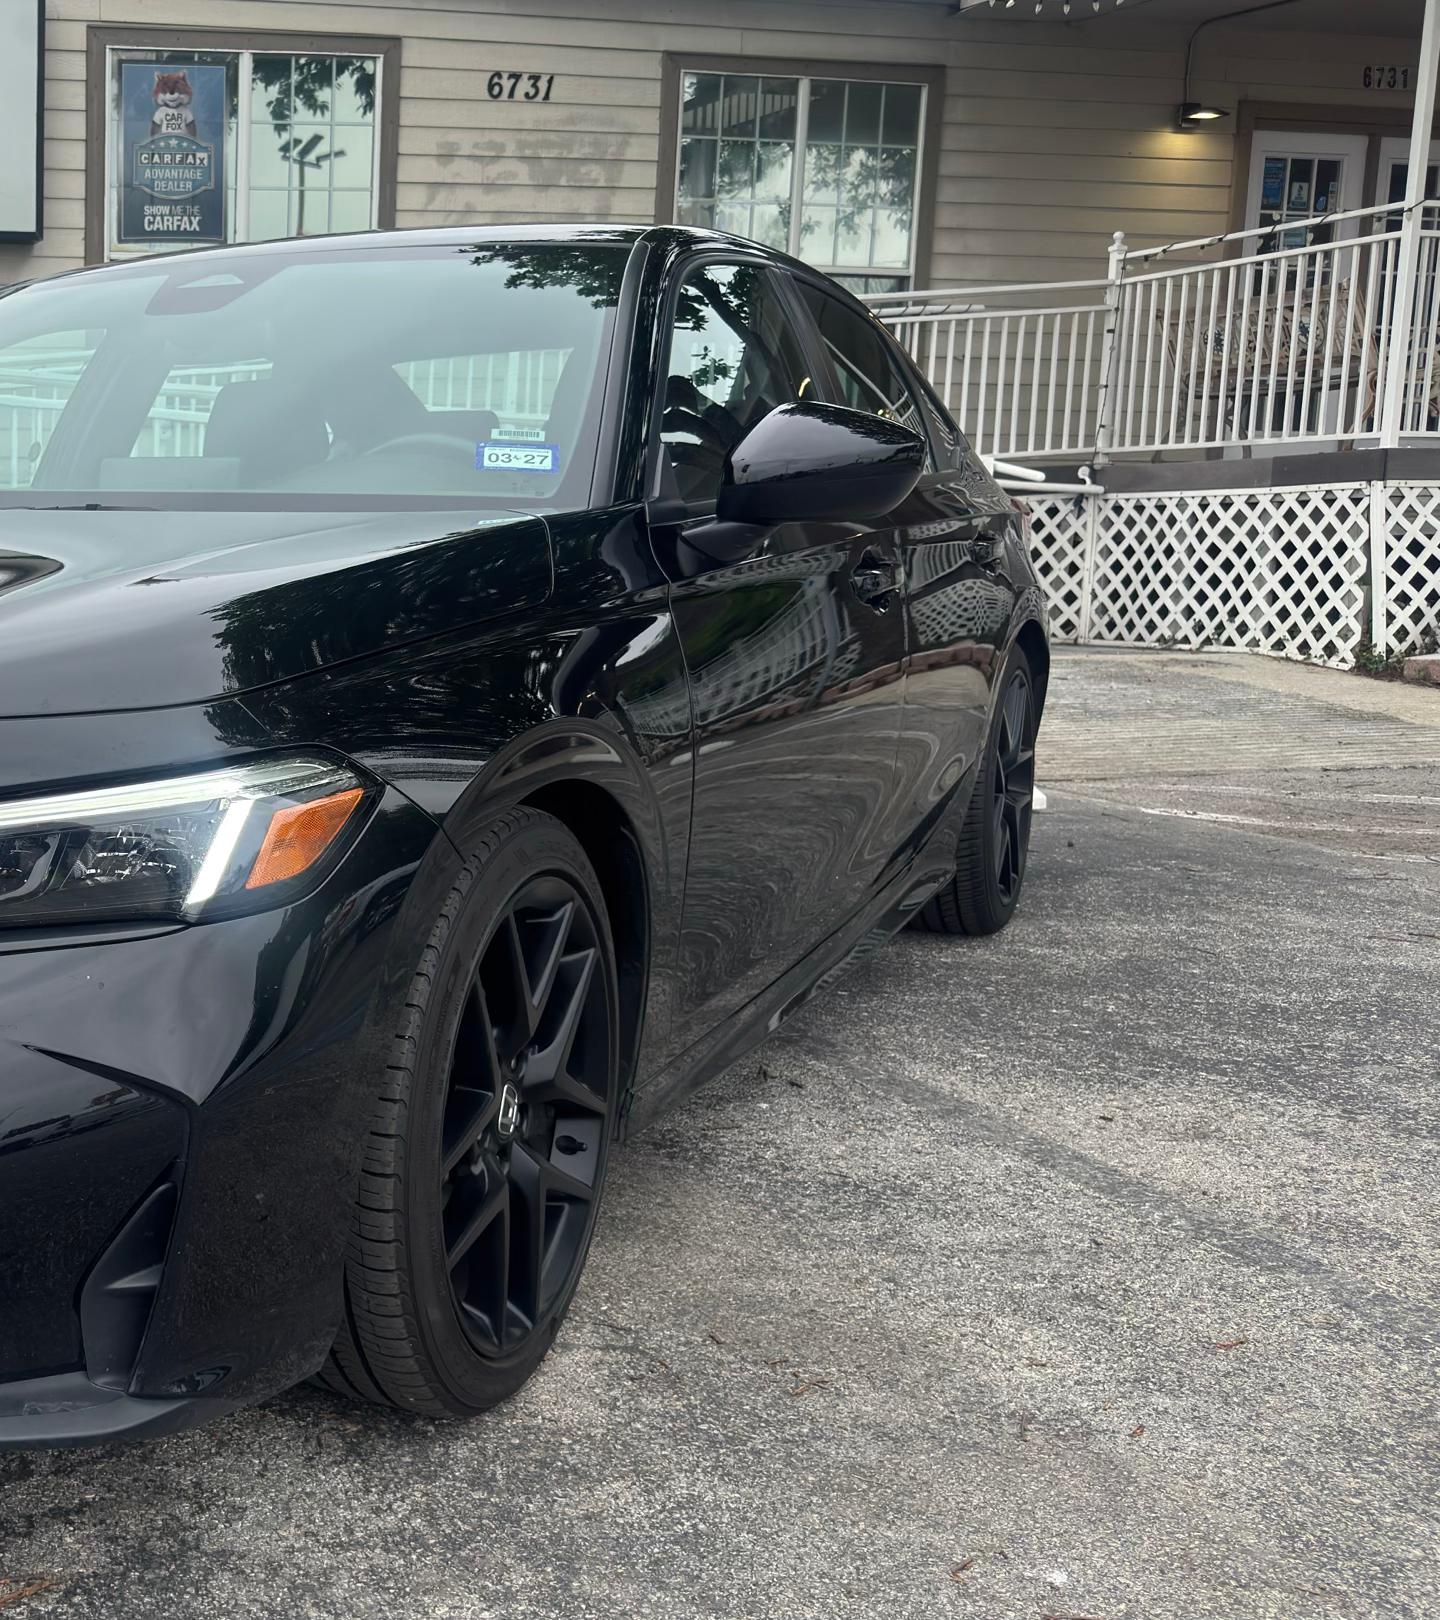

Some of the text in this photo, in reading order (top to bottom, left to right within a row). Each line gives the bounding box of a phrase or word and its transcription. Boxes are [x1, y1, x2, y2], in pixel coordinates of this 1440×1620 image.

[1363, 66, 1409, 89] 6731
[487, 71, 555, 101] 6731
[165, 113, 183, 122] CAR
[166, 123, 182, 131] FOX
[140, 153, 208, 166] CARFAX
[144, 169, 203, 180] ADVANTAGE
[154, 182, 193, 192] DEALER
[144, 206, 200, 216] SHOW ME THE
[144, 217, 200, 231] CARFAX
[488, 453, 549, 465] 03 27
